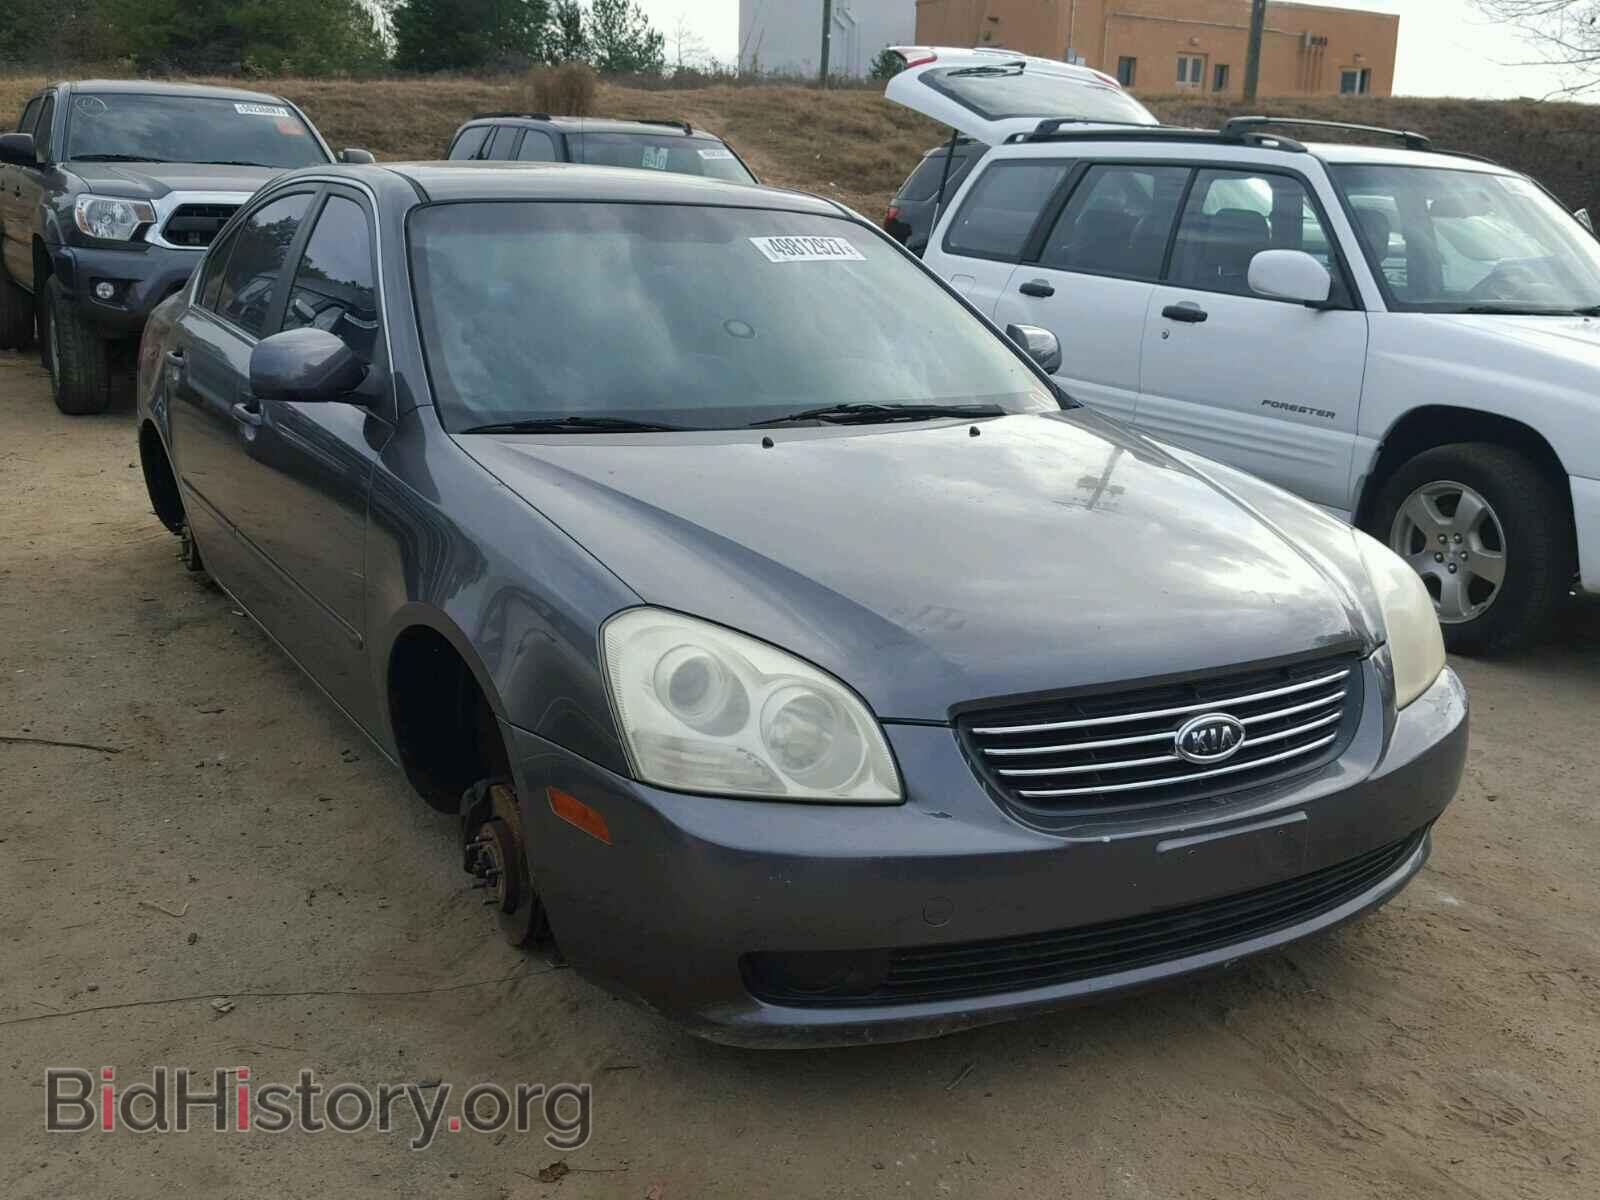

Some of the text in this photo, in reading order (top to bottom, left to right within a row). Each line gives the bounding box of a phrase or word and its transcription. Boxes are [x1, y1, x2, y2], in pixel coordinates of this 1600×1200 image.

[767, 238, 847, 256] 49812927
[1261, 399, 1336, 419] FORESTER
[1191, 725, 1234, 754] KIA
